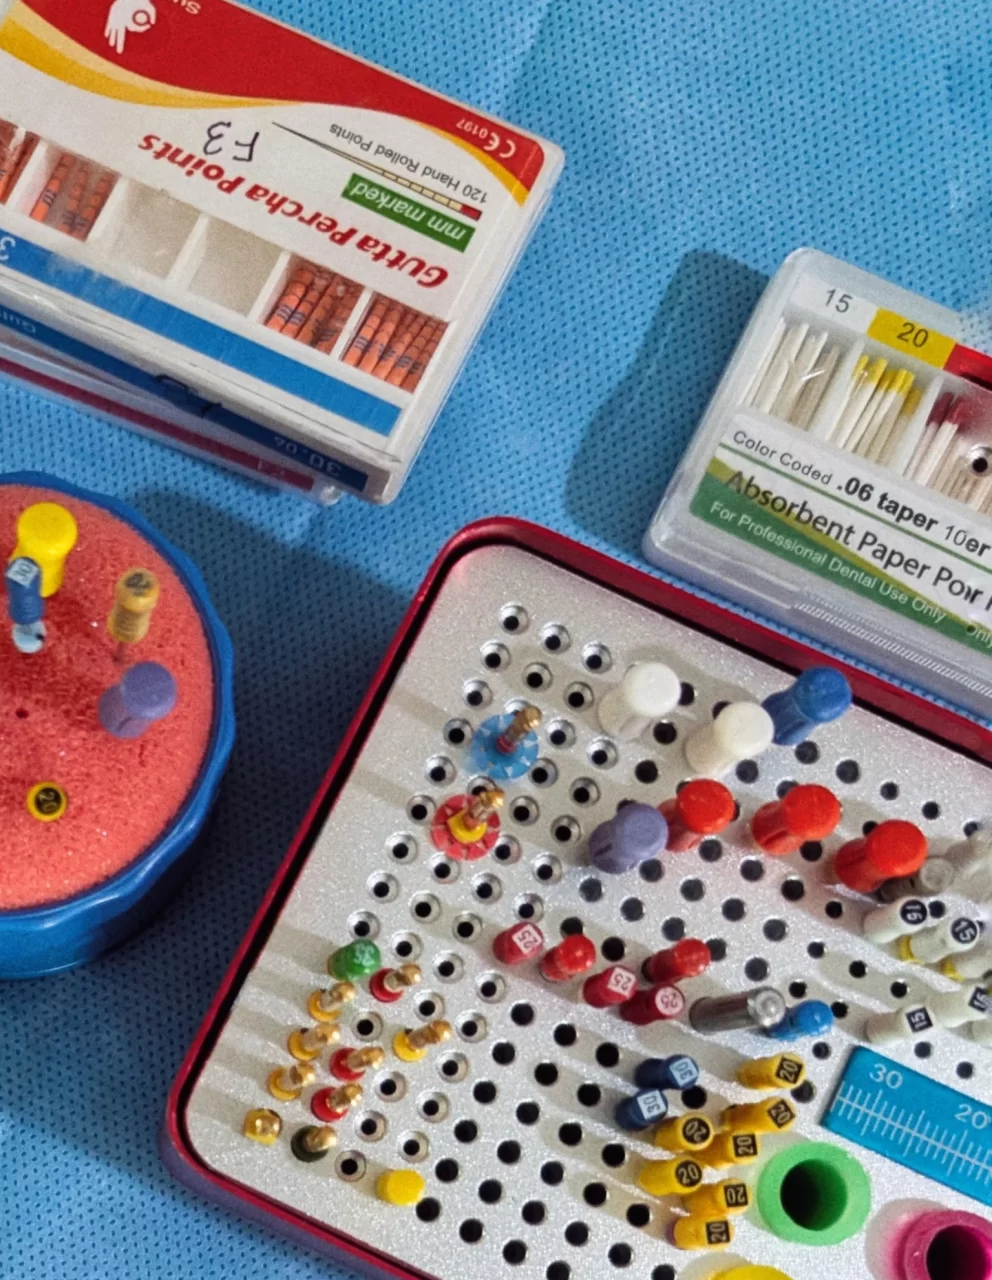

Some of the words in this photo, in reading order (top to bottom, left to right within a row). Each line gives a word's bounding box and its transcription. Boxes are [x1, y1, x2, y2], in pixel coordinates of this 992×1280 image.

[202, 120, 260, 163] F3
[329, 123, 372, 152] Points
[456, 119, 488, 139] 0197
[139, 134, 244, 193] Points
[373, 144, 419, 173] Rolled
[420, 165, 461, 191] Hand
[349, 181, 426, 222] marked
[461, 183, 487, 204] 120
[245, 184, 357, 245] Percha
[427, 215, 466, 240] mm
[356, 234, 448, 288] Gutta
[825, 288, 852, 313] 15
[896, 319, 929, 348] 20
[732, 430, 777, 458] Color
[779, 451, 833, 485] Coded
[837, 477, 874, 502] .06
[876, 492, 938, 531] taper
[723, 472, 853, 543] Absorbent
[854, 531, 930, 578] Paper
[709, 500, 737, 522] For
[737, 513, 828, 565] Professional
[828, 557, 878, 588] Dental
[876, 580, 908, 606] Use
[908, 596, 948, 626] Only
[517, 929, 538, 950] 25
[953, 919, 976, 943] 15
[610, 972, 631, 992] 25
[910, 1010, 927, 1028] 15
[675, 1060, 692, 1080] 30
[777, 1058, 800, 1082] 20
[869, 1062, 903, 1090] 30
[642, 1095, 660, 1113] 30
[770, 1102, 792, 1124] 20
[955, 1103, 991, 1130] 20
[683, 1119, 707, 1142] 20
[734, 1135, 755, 1155] 20
[677, 1163, 702, 1187] 20
[725, 1183, 745, 1202] 20
[710, 1222, 726, 1242] 20
